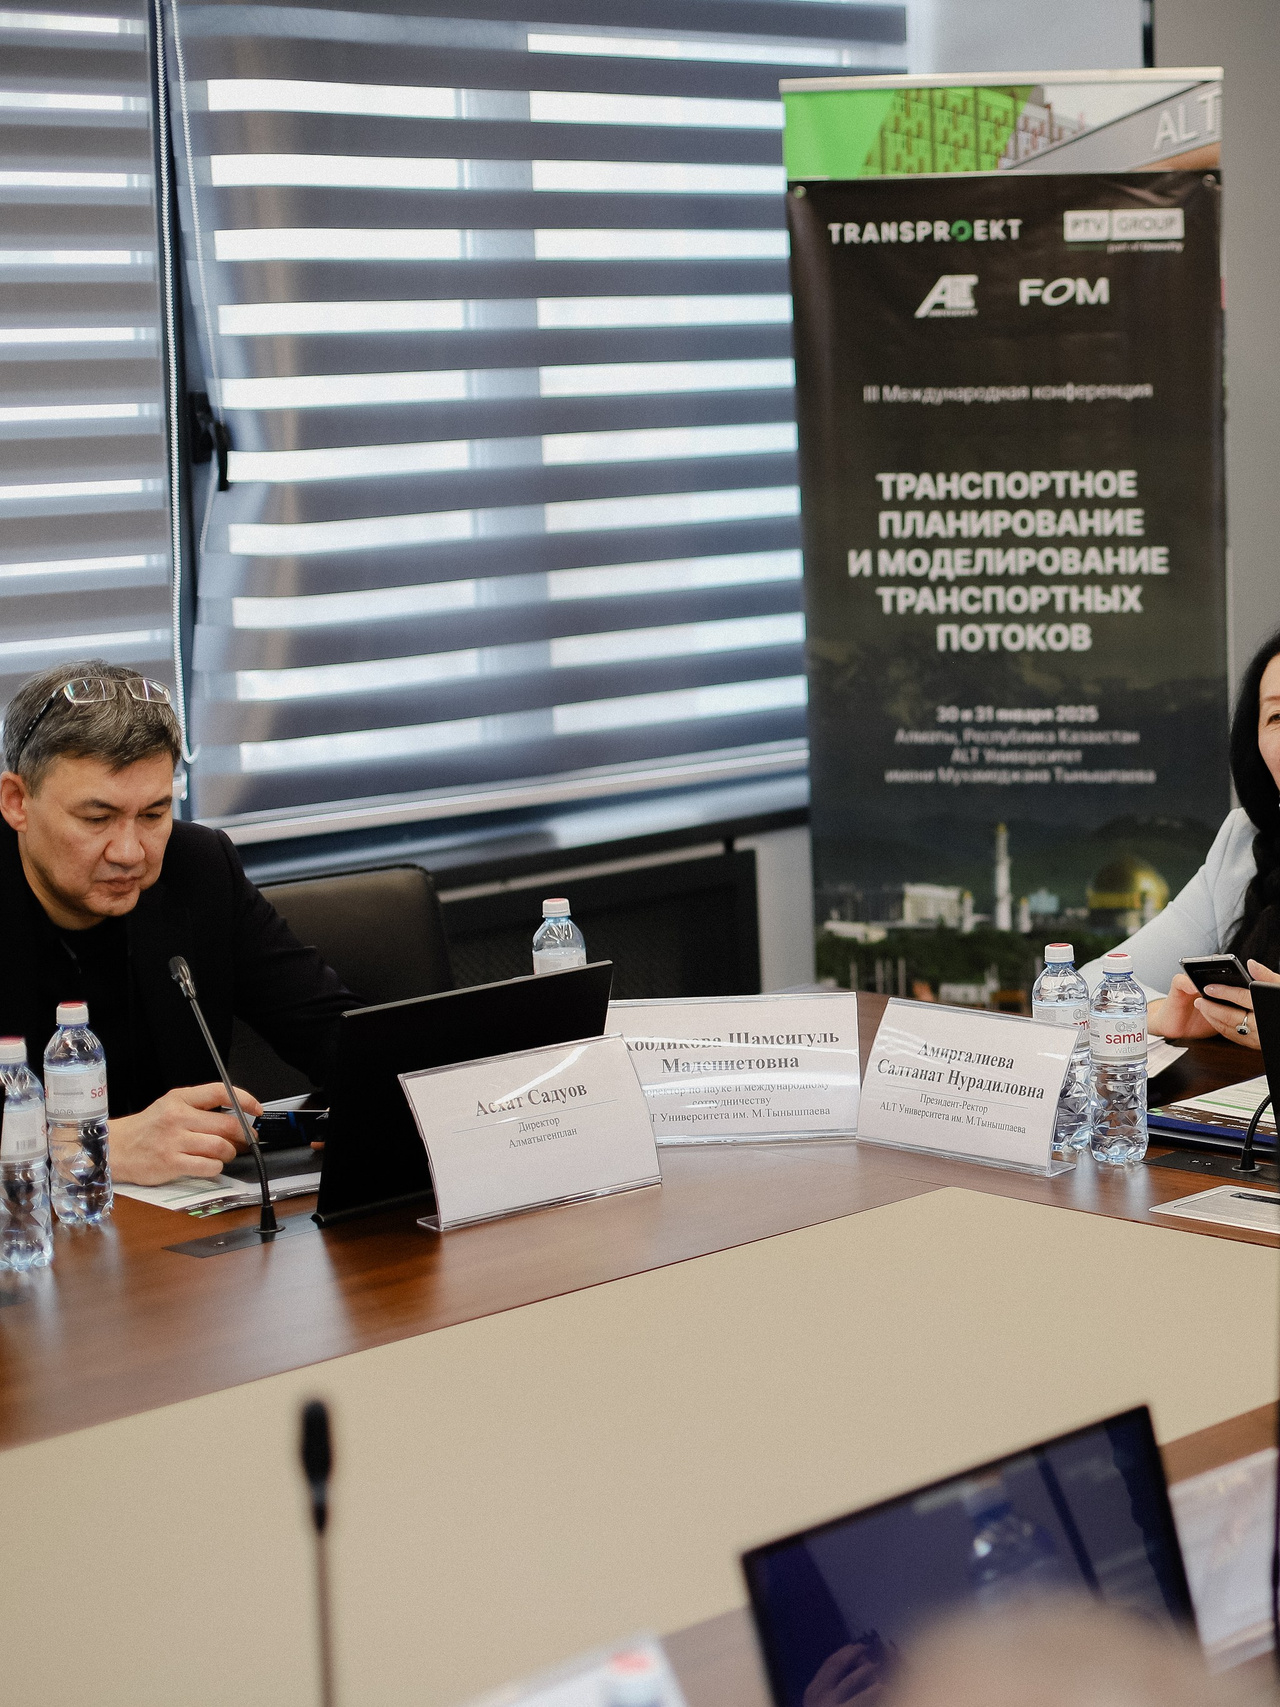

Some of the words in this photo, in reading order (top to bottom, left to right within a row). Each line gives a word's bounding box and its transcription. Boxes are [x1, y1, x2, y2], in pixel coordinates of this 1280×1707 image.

[1153, 88, 1222, 150] ALT
[828, 218, 1023, 245] TRANSPROEKT
[1116, 215, 1177, 232] GROUP
[1019, 277, 1110, 307] FOM
[882, 384, 1031, 405] Международная
[1032, 381, 1154, 403] конференция
[875, 470, 1138, 501] ТРАНСПОРТНОЕ
[878, 508, 1145, 539] ПЛАНИРОВАНИЕ
[848, 549, 873, 577] И
[877, 547, 1170, 582] МОДЕЛИРОВАНИЕ
[875, 585, 1144, 615] ТРАНСПОРТНЫХ
[936, 623, 1093, 652] ПОТОКОВ
[728, 1030, 840, 1050] Шамсигуль
[1105, 1028, 1145, 1045] samal
[917, 1041, 1015, 1070] Амиргалиева
[877, 1058, 945, 1083] Салтанат
[947, 1069, 1045, 1099] Нурадиловна
[476, 1096, 524, 1117] Асхат
[527, 1084, 588, 1106] Садуов
[919, 1093, 989, 1115] Президент-Ректор
[518, 1116, 561, 1133] Директор
[660, 1111, 730, 1124] Университета
[732, 1111, 749, 1120] им.
[751, 1107, 831, 1119] М.Тынышпаева
[898, 1103, 950, 1122] Университета
[951, 1113, 964, 1124] им.
[965, 1115, 1027, 1134] М.Тынышпаева
[509, 1128, 578, 1149] Алматыгенплан
